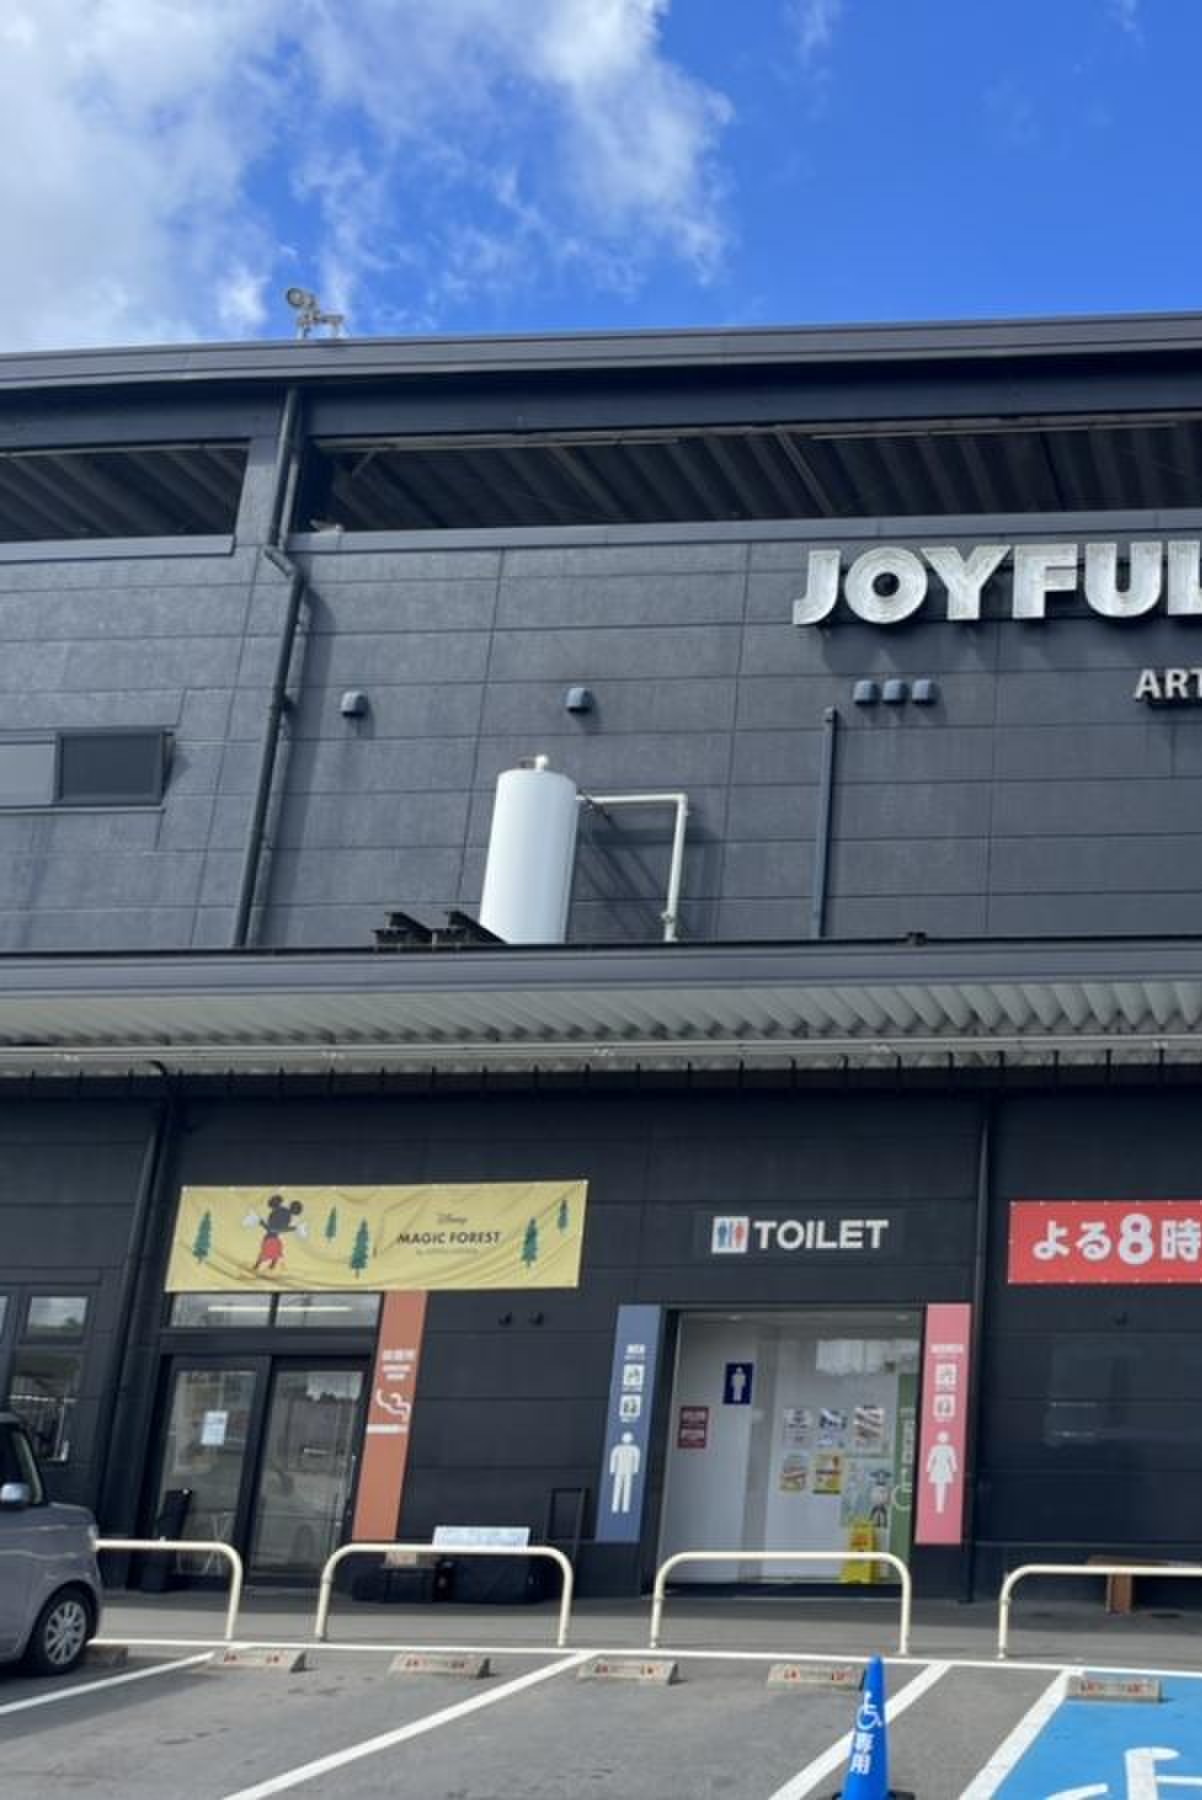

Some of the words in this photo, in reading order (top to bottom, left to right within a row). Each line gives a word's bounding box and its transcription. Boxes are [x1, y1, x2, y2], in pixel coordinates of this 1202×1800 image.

[398, 1232, 446, 1245] MAGIC
[449, 1230, 502, 1244] FOREST
[753, 1219, 890, 1250] TOILET
[850, 1731, 875, 1776] 専用
